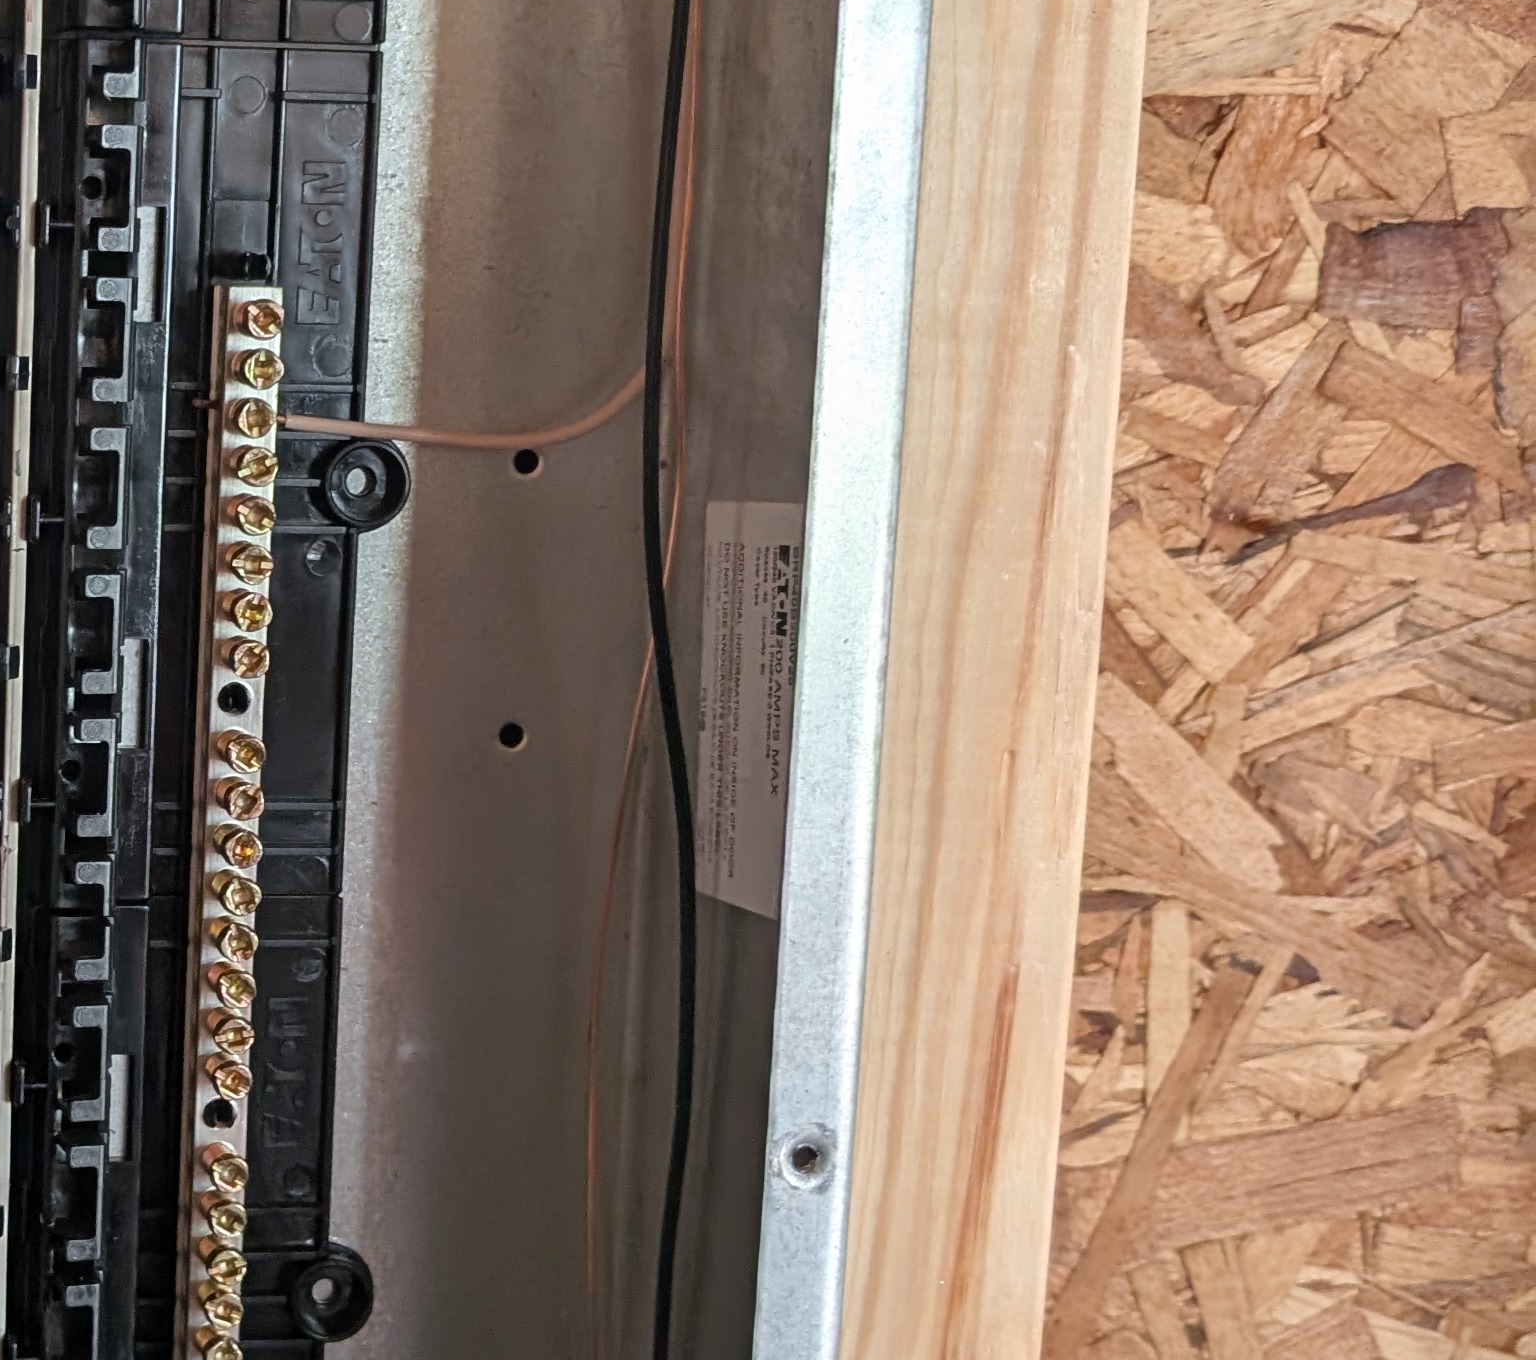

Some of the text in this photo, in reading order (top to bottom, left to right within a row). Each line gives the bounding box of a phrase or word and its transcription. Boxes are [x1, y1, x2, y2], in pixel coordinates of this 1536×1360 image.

[295, 160, 346, 325] EATON
[776, 544, 790, 637] EATON
[770, 748, 780, 796] MAX
